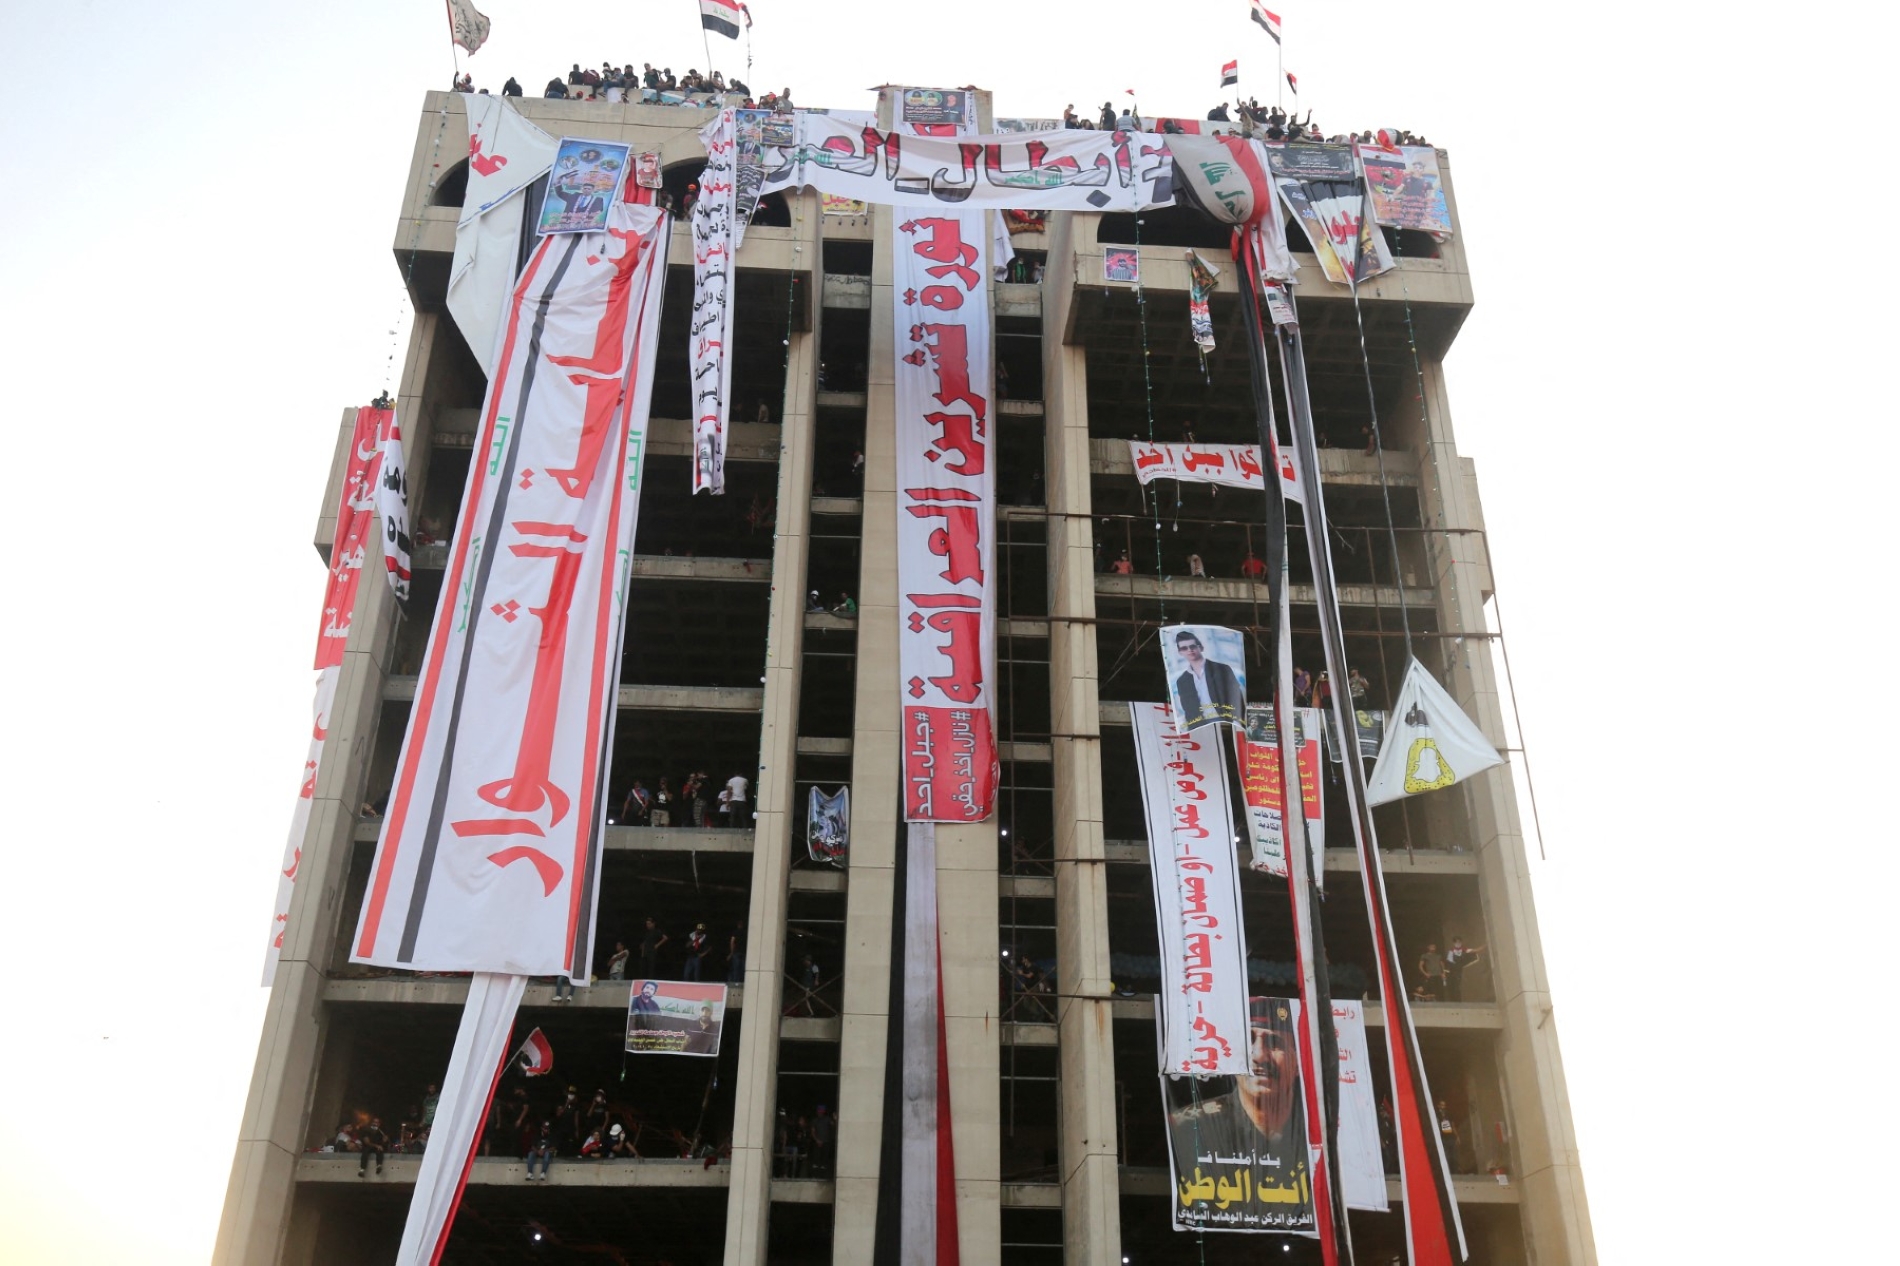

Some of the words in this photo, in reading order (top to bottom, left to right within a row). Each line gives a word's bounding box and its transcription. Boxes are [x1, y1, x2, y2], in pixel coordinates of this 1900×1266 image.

[898, 217, 981, 312] ثورة
[902, 321, 986, 476] تشرين
[904, 487, 985, 704] العراقية
[451, 520, 588, 897] الثوار
[1178, 1167, 1251, 1209] الوطن
[1257, 1161, 1309, 1205] أنت
